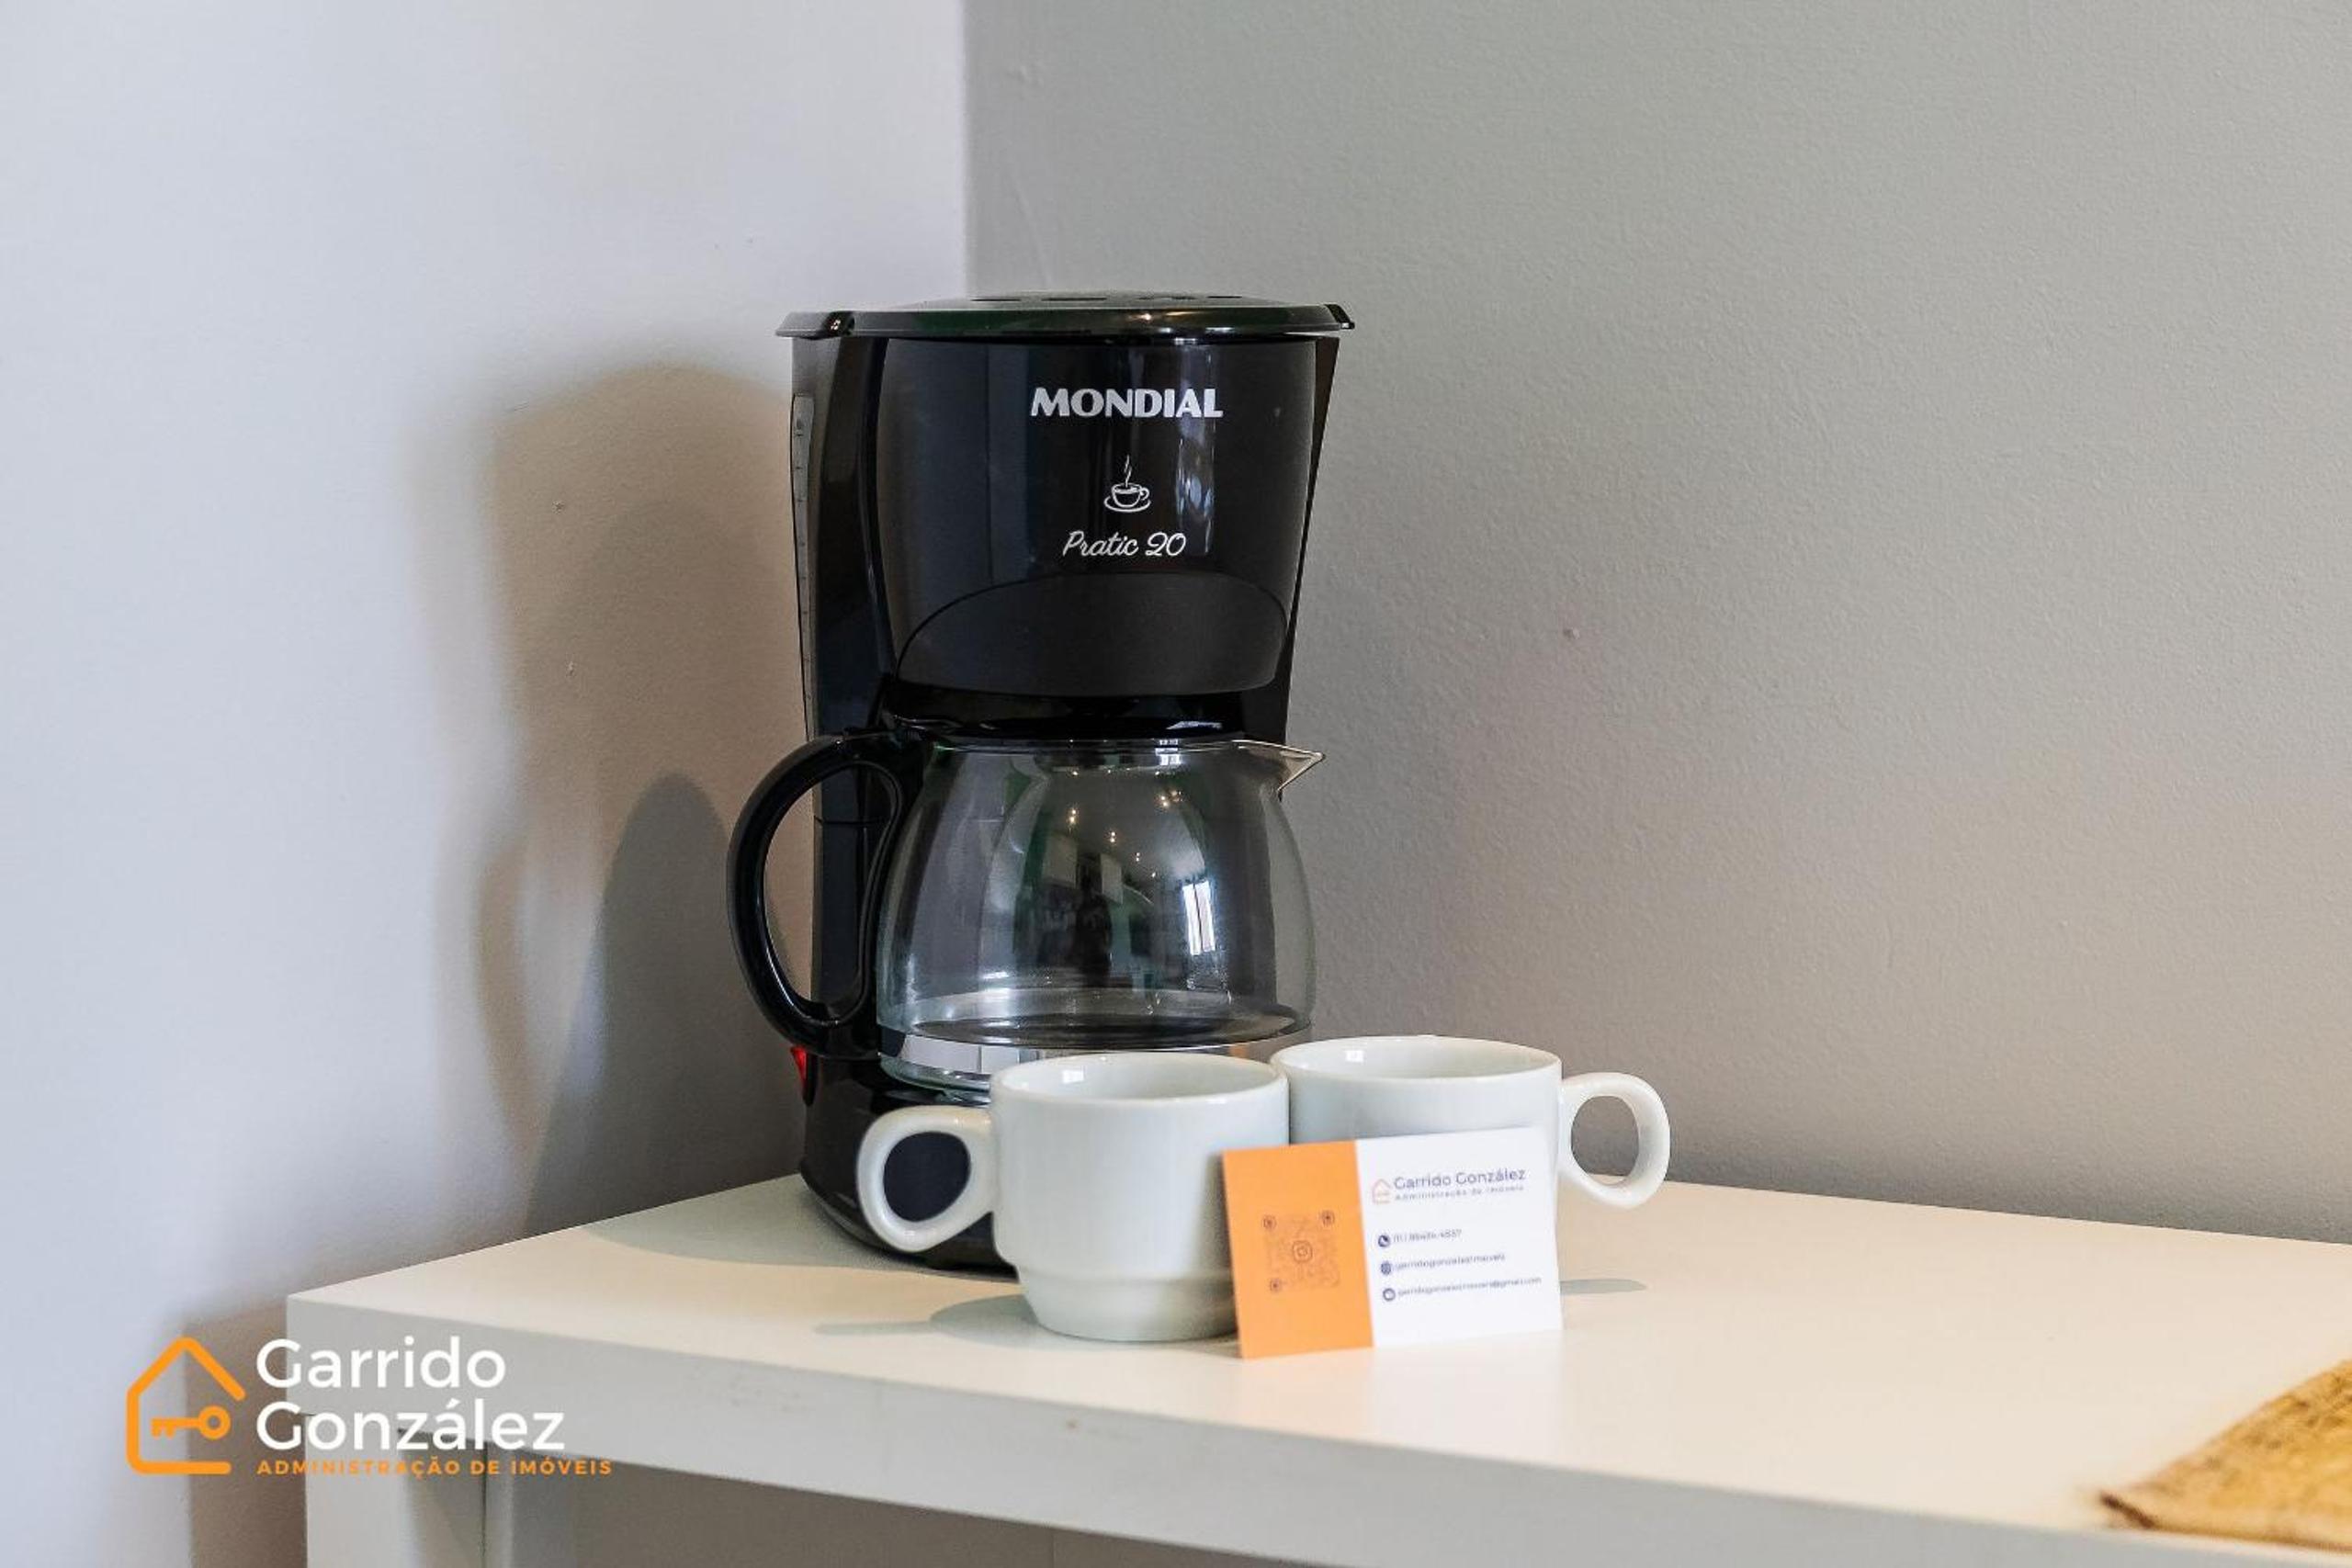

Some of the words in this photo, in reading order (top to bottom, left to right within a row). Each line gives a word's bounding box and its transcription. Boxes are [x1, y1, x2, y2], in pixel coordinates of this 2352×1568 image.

[1030, 387, 1224, 417] MONDIAL
[1063, 530, 1139, 557] Pratic
[1145, 531, 1187, 557] 20
[1394, 1174, 1452, 1190] Garrido
[1455, 1168, 1527, 1186] González
